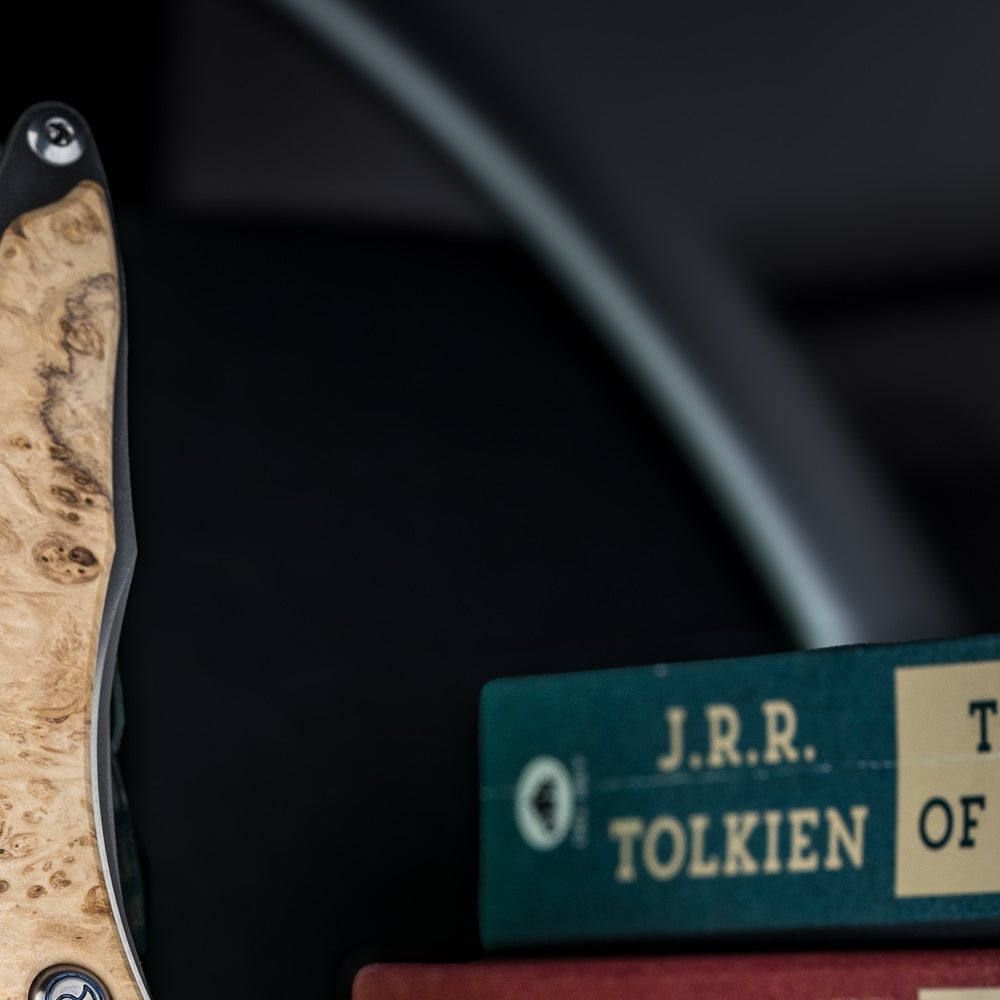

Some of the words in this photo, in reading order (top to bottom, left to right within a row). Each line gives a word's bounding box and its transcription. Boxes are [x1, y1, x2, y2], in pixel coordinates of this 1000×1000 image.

[657, 699, 817, 771] J.R.R.
[608, 806, 868, 882] TOLKIEN
[919, 796, 985, 851] OF
